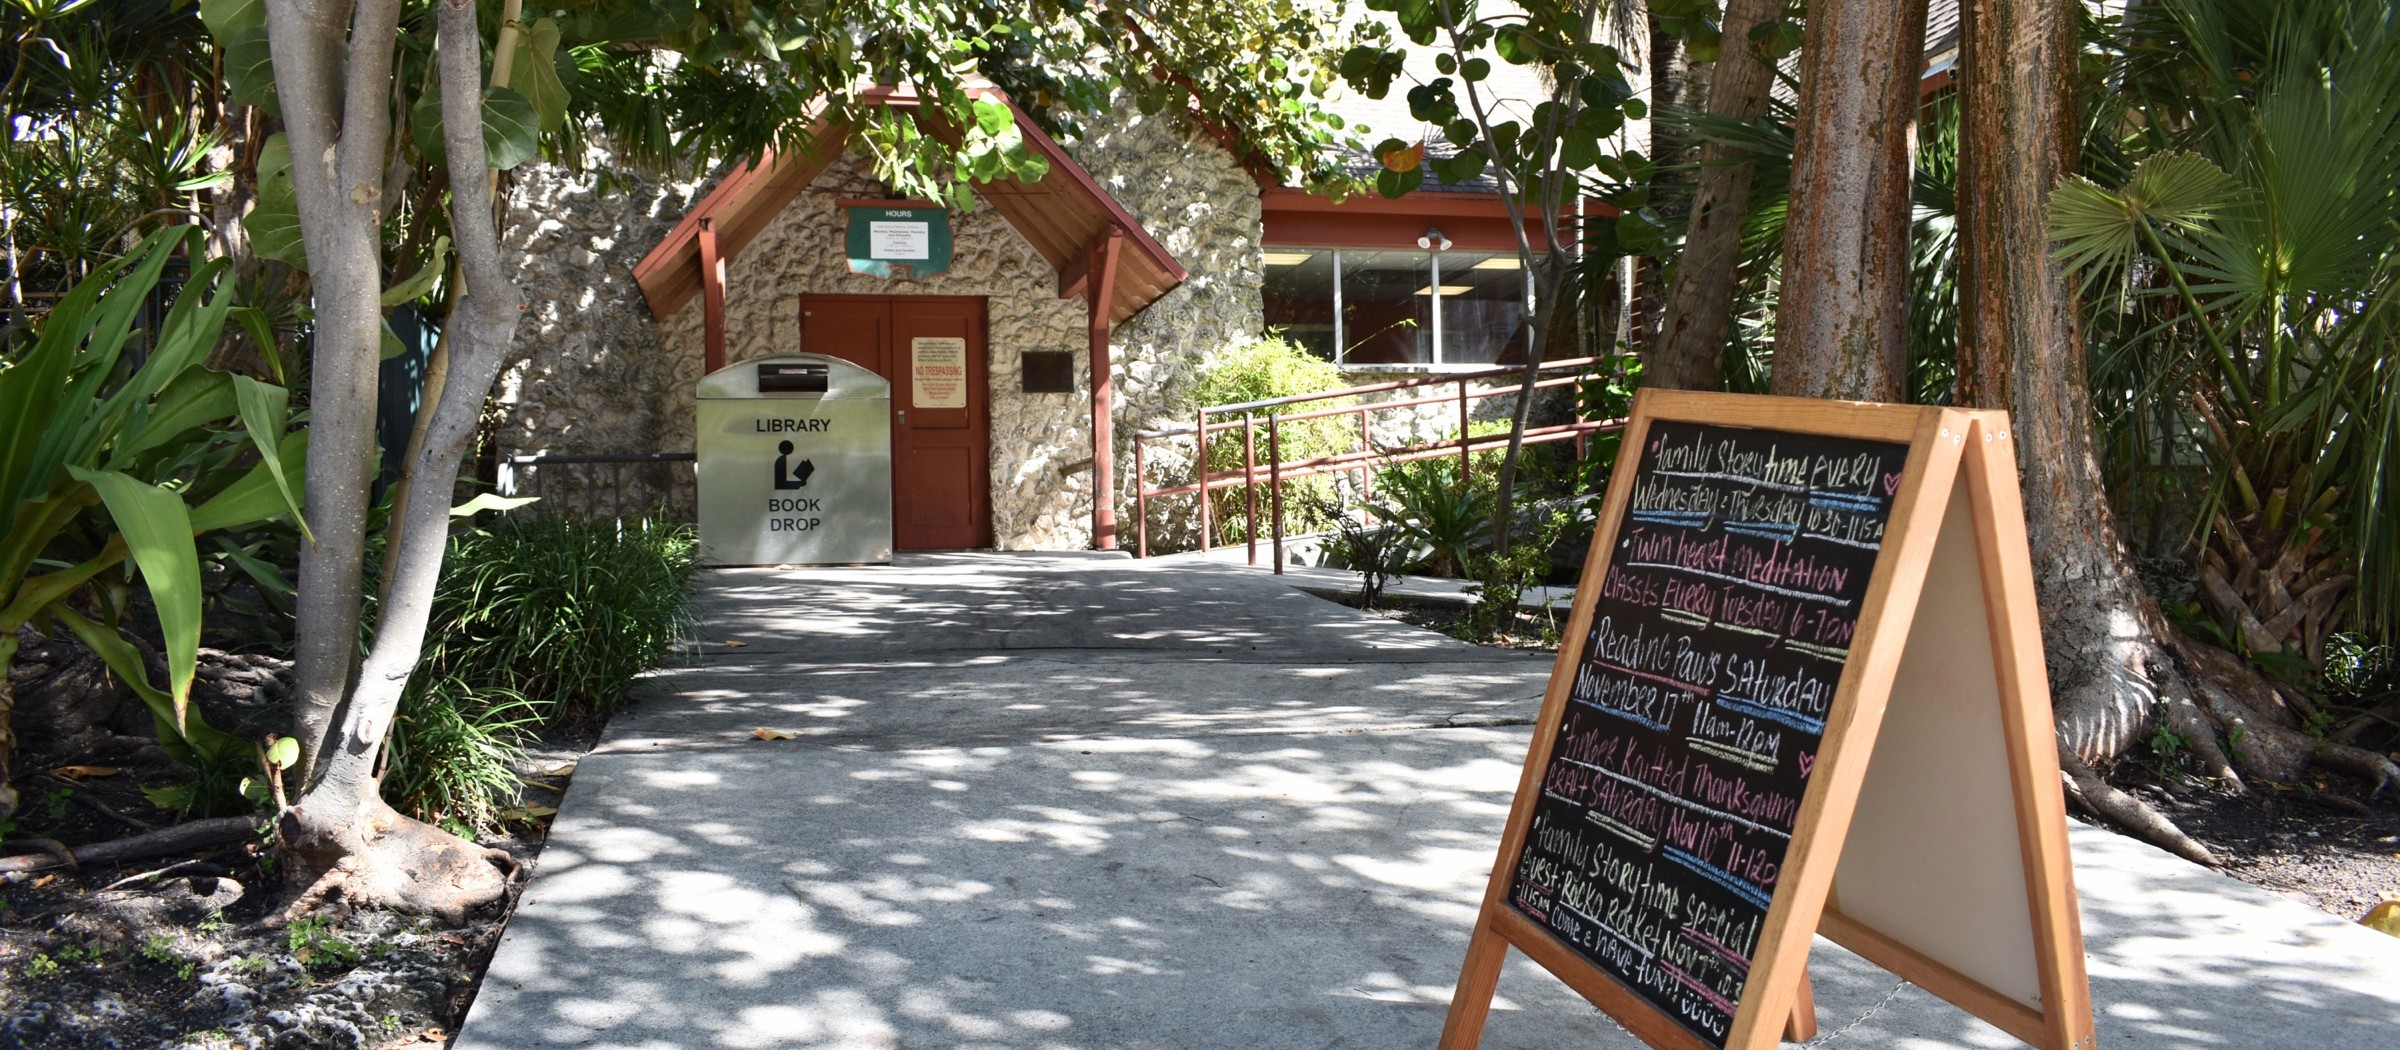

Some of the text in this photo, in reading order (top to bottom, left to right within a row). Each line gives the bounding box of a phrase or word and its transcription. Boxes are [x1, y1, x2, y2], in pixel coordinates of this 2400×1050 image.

[916, 366, 962, 376] NO TRESPASSING
[756, 419, 831, 433] LIBRARY
[769, 499, 821, 512] BOOK
[770, 518, 820, 531] DROP
